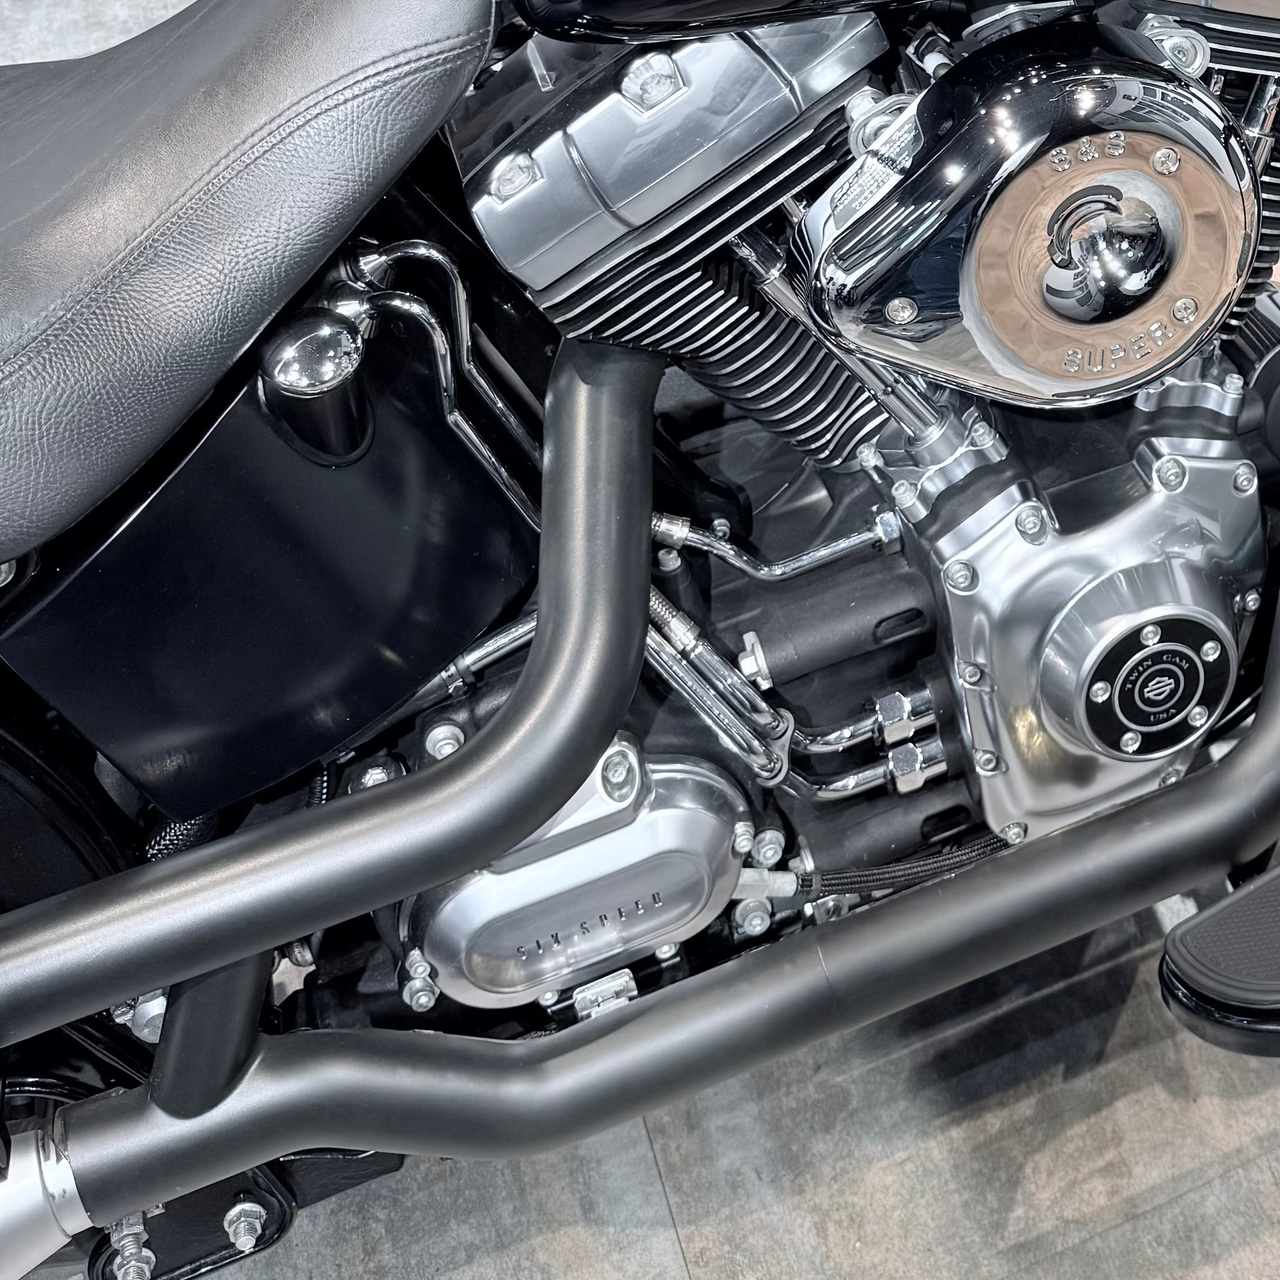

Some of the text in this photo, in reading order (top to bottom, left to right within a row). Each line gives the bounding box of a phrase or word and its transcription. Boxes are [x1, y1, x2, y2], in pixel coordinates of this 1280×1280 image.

[1062, 322, 1173, 373] SUPER
[1125, 659, 1153, 690] TWIN
[516, 932, 561, 960] SIX
